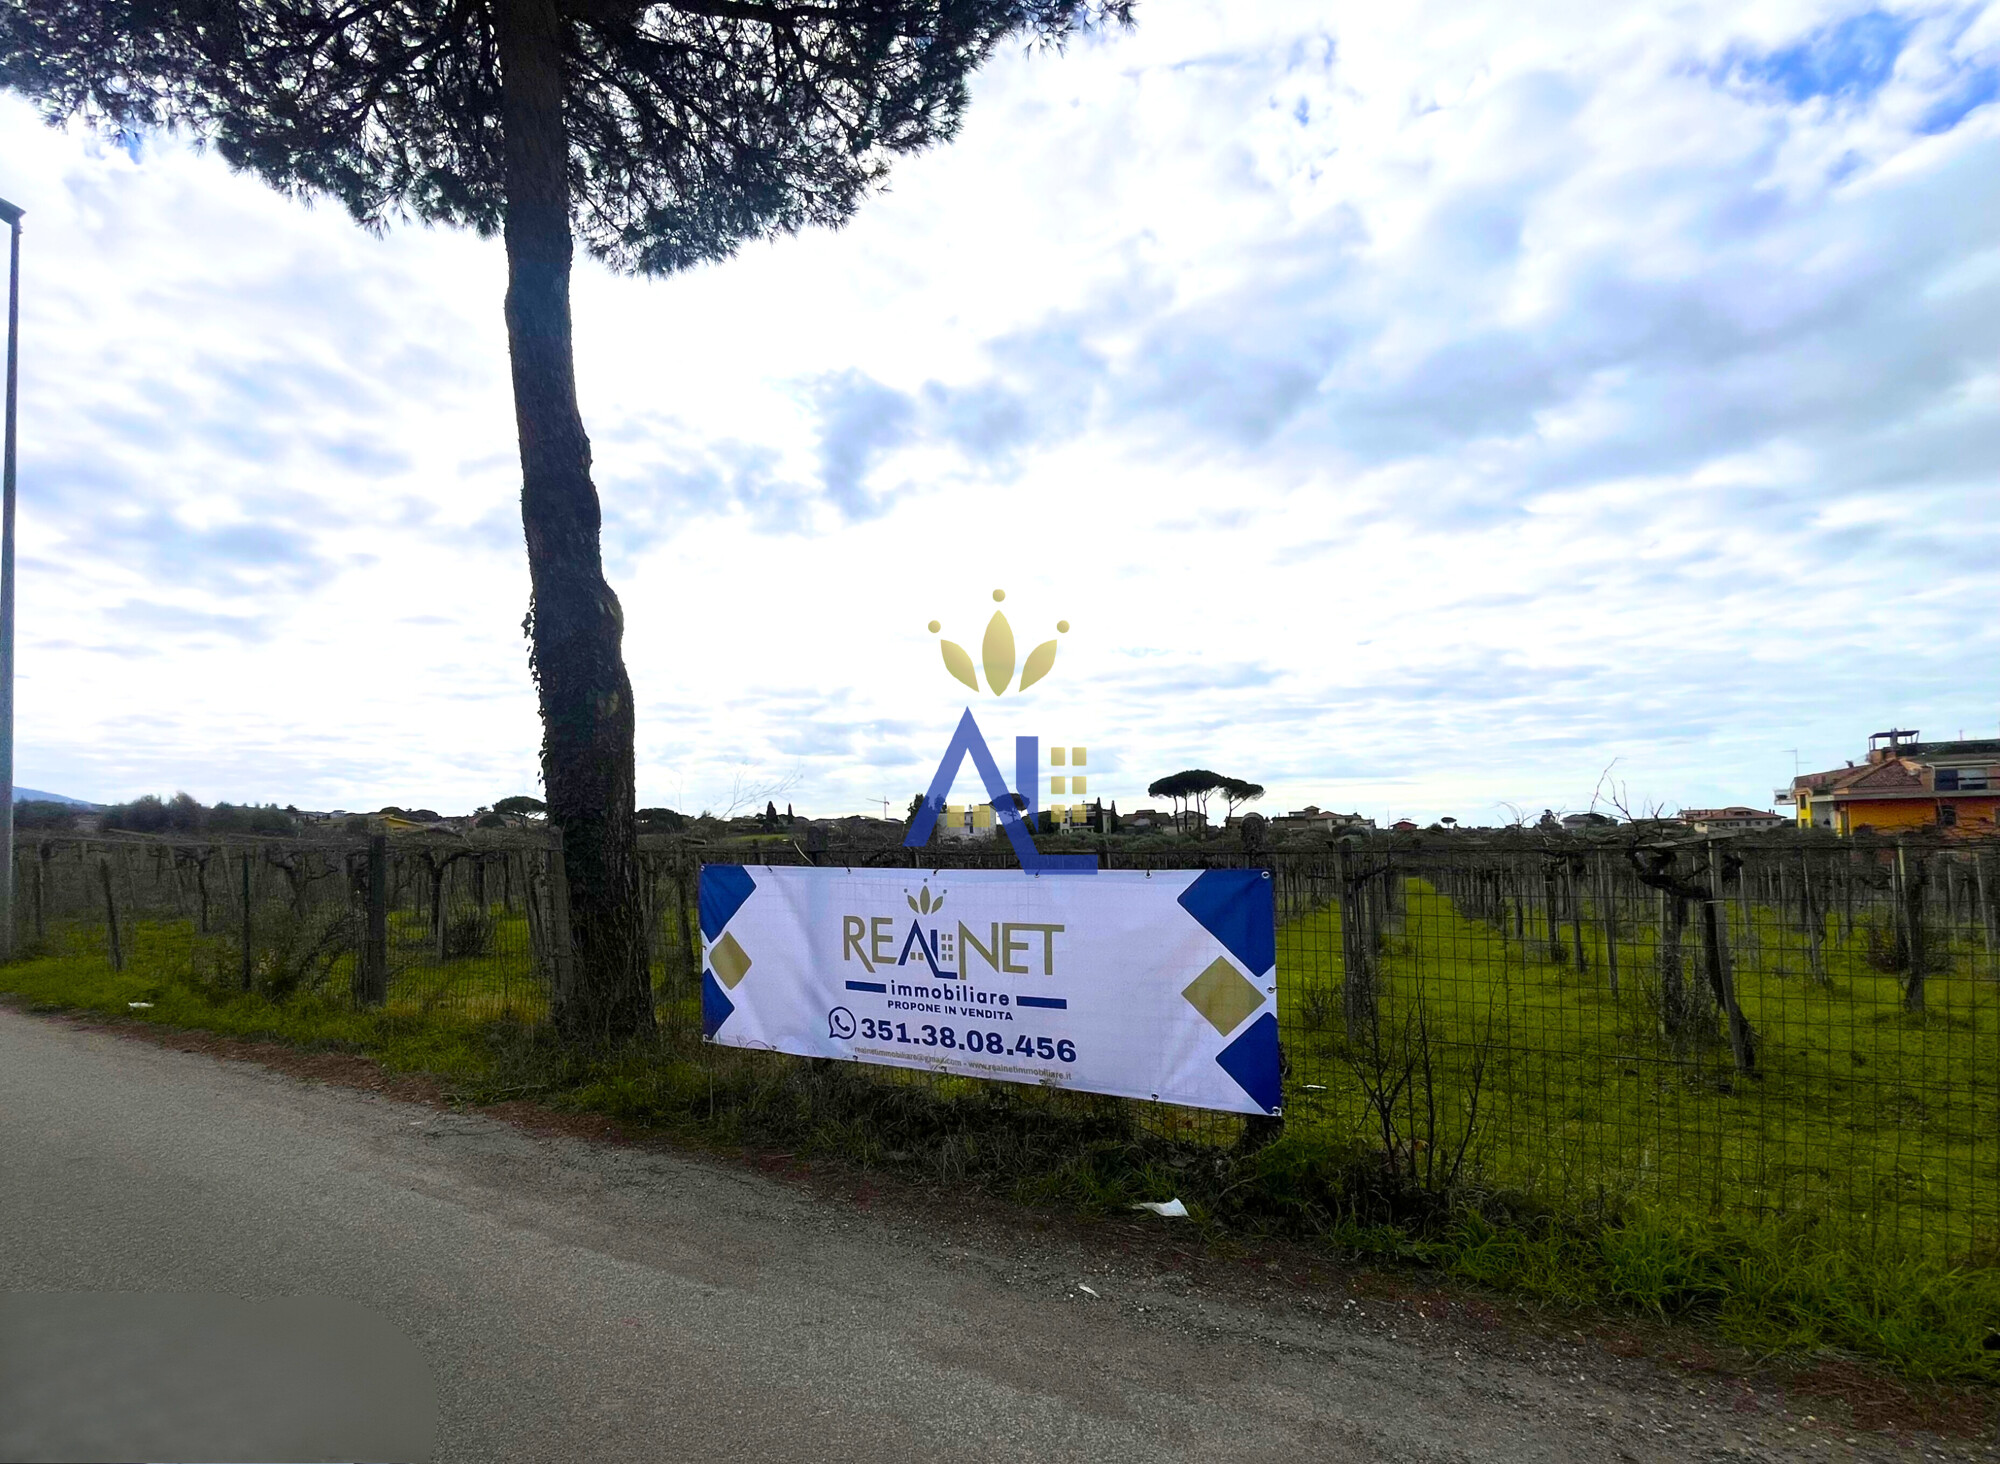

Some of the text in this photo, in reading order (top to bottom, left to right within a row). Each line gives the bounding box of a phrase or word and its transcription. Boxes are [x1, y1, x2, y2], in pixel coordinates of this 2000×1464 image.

[843, 915, 1065, 980] REALNET
[890, 979, 1010, 1006] immobiliare
[887, 1000, 1013, 1021] PROPONE IN VENDITA
[861, 1018, 1077, 1062] 351.38.08.456
[968, 1061, 1072, 1080] www.realnetimmobiliare.it
